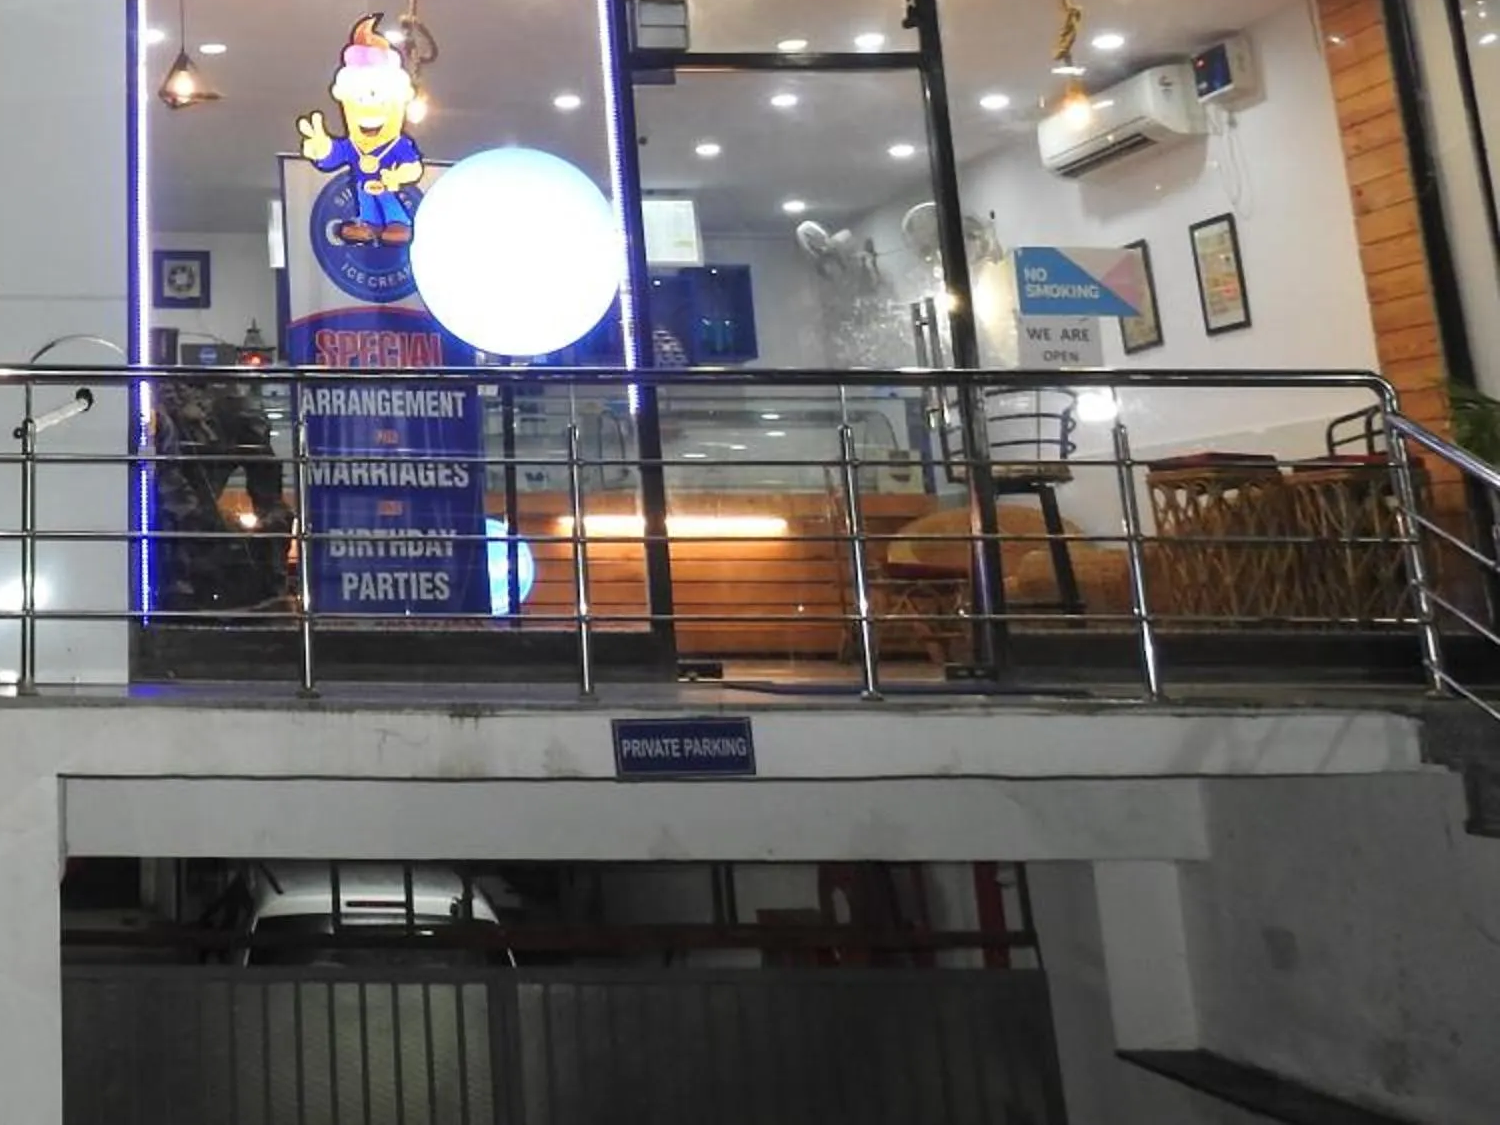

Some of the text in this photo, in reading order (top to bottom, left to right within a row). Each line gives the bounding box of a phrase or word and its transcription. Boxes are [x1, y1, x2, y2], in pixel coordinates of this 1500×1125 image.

[340, 262, 365, 284] ICE
[1023, 266, 1048, 283] NO
[1025, 283, 1100, 299] SMOKING
[1025, 327, 1091, 343] WE ARE
[1042, 349, 1080, 363] OPEN
[302, 387, 467, 418] ARRANGEMENT
[307, 460, 470, 488] MARRIAGES
[327, 527, 457, 558] BIRTHDAY
[341, 571, 451, 601] PARTIES
[620, 736, 748, 759] PRIVATE PARKING
